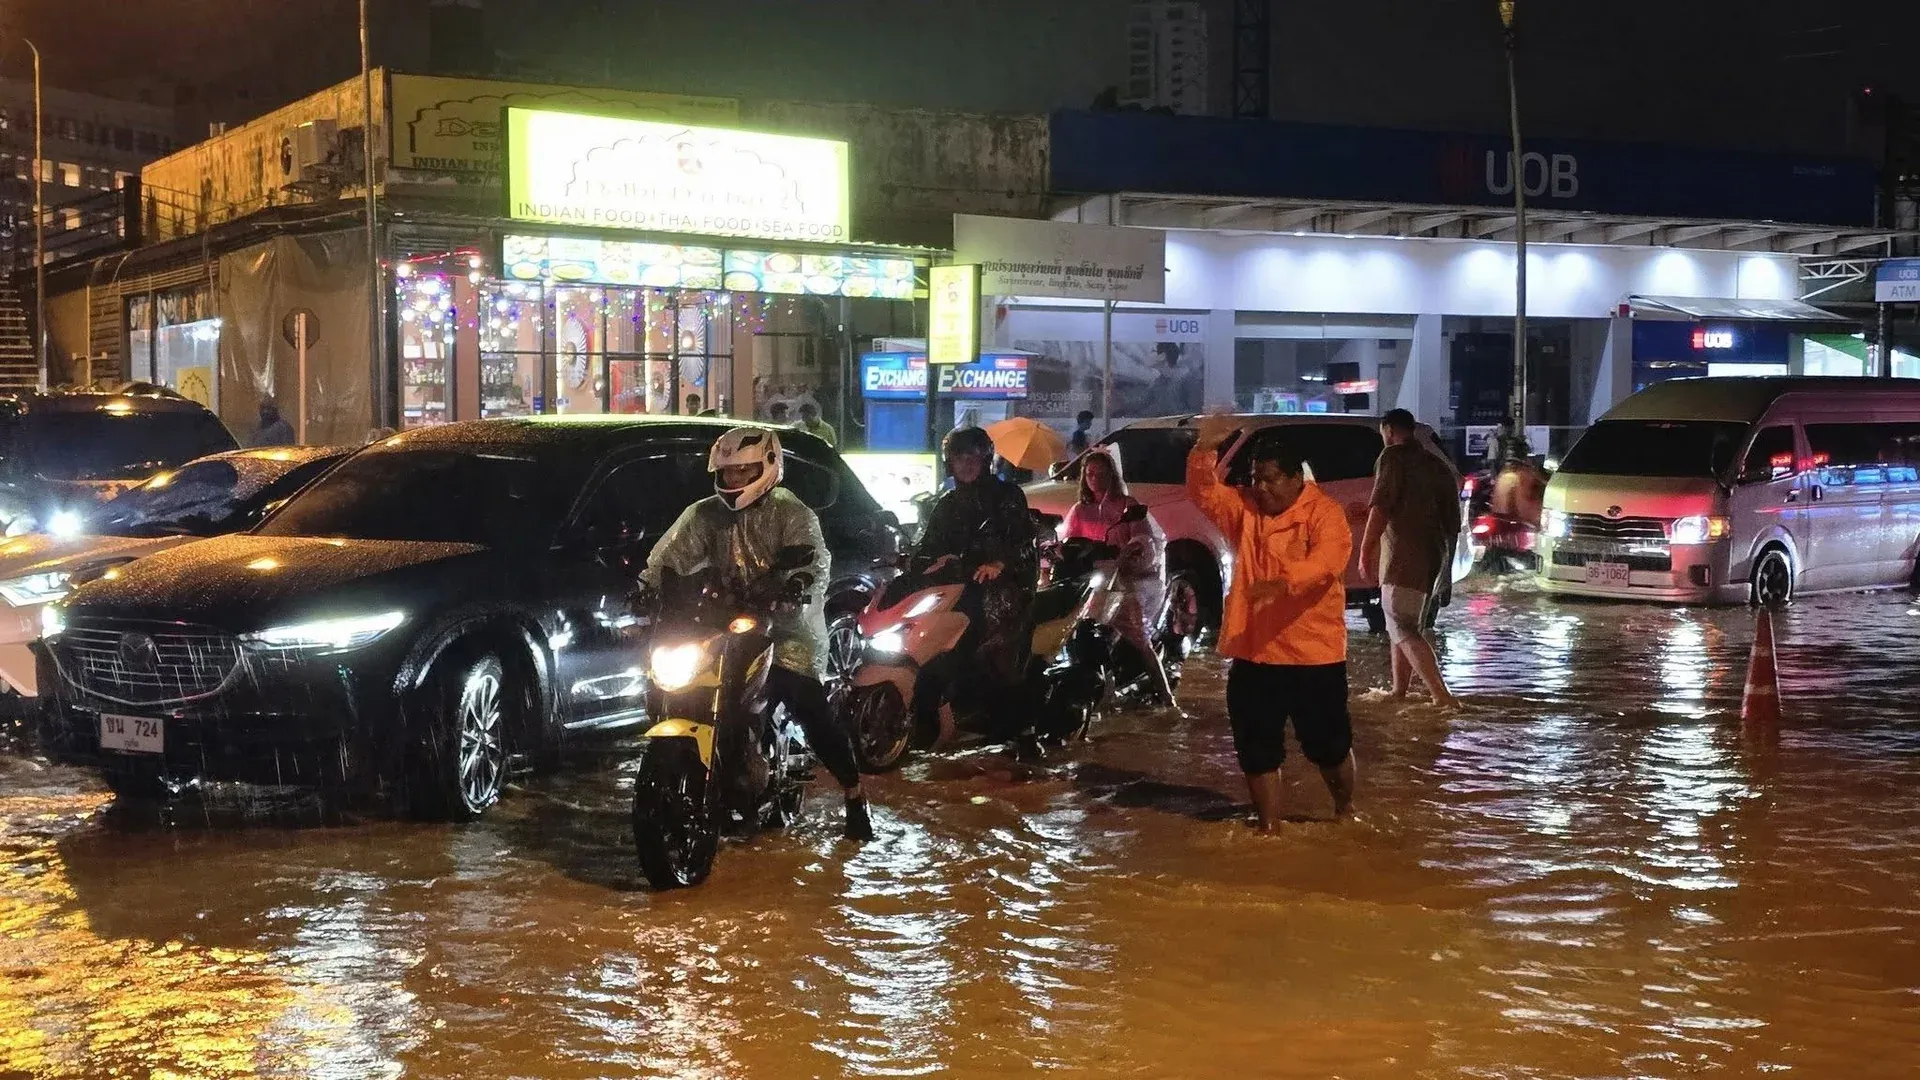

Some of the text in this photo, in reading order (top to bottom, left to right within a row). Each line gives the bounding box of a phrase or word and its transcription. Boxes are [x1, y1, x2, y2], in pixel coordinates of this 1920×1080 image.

[411, 156, 469, 169] INDIAN
[1486, 150, 1579, 198] UOB
[518, 203, 586, 220] INDIAN
[594, 208, 646, 224] FOOD
[703, 216, 751, 231] FOOD
[761, 220, 794, 233] SEA
[799, 223, 843, 237] FOOD
[1898, 269, 1918, 279] UOB
[1891, 286, 1917, 298] ATM
[1170, 320, 1199, 333] UOB
[1704, 333, 1733, 348] UOB
[866, 366, 927, 390] EXCHANG
[937, 365, 1027, 392] EXCHANGE
[135, 720, 158, 737] 724
